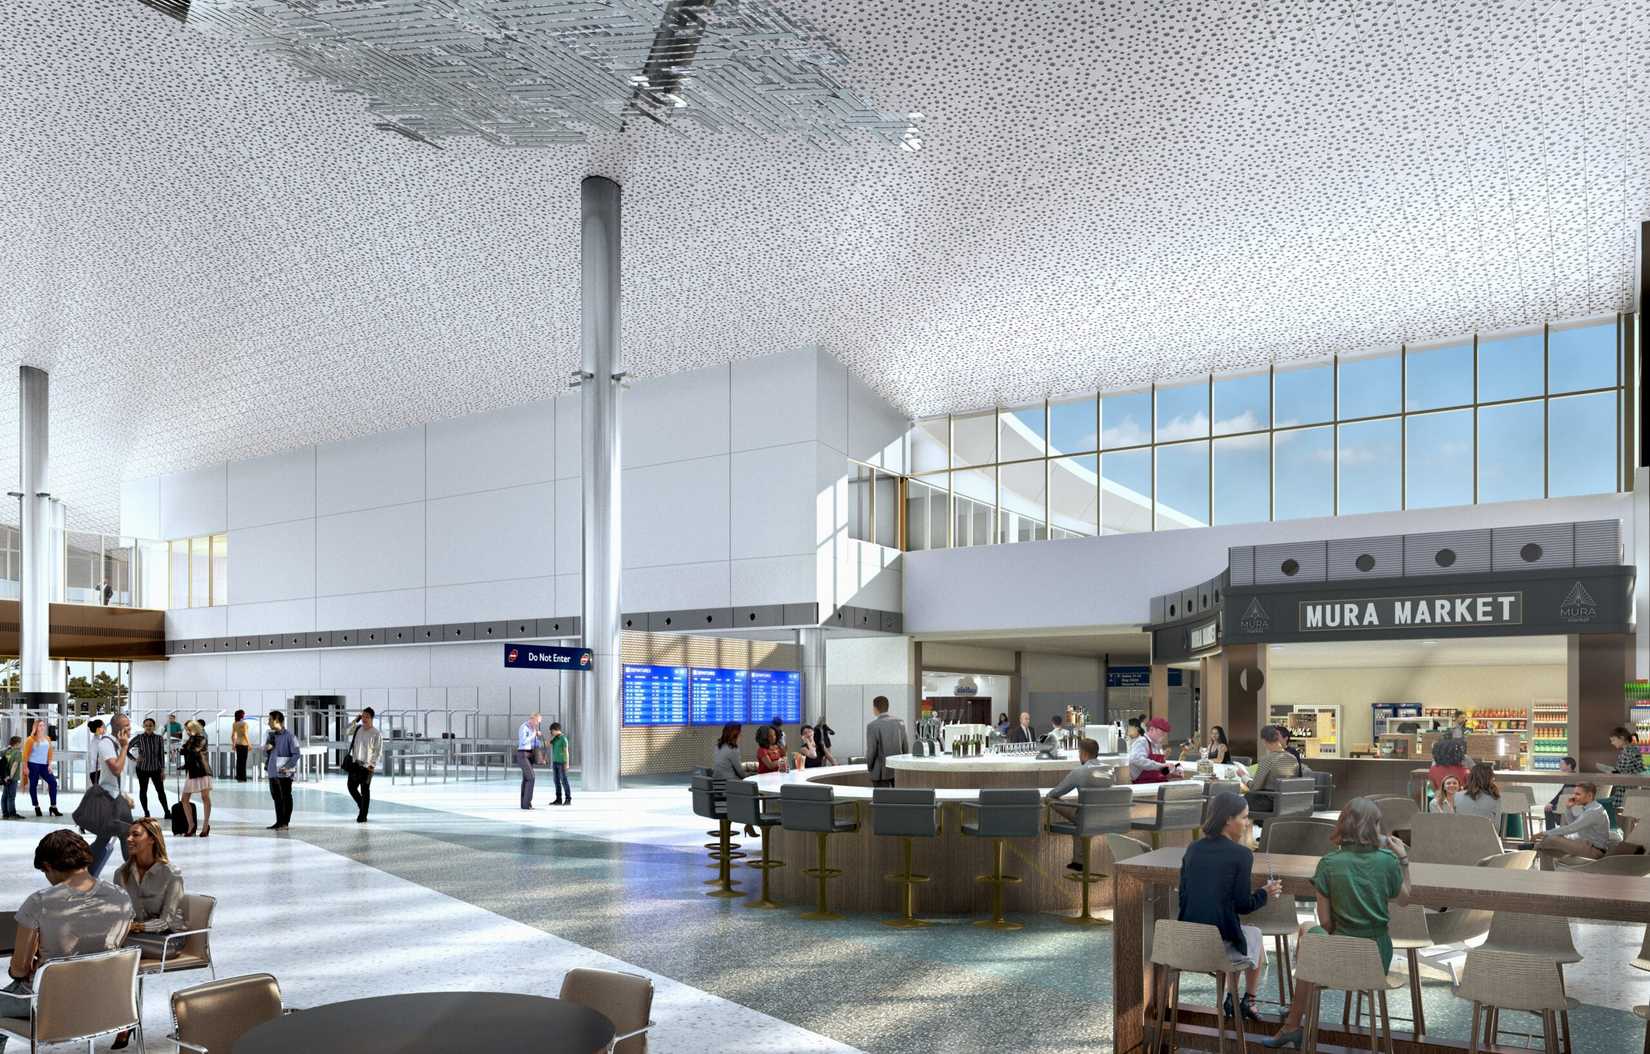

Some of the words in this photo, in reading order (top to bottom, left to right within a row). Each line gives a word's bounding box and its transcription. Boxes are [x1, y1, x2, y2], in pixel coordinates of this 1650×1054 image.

[1306, 602, 1380, 628] MURA
[1394, 596, 1516, 625] MARKET
[1560, 607, 1596, 617] MURA
[1240, 620, 1269, 628] MURA
[528, 652, 538, 662] Do
[539, 653, 552, 662] Not
[553, 653, 571, 663] Enter
